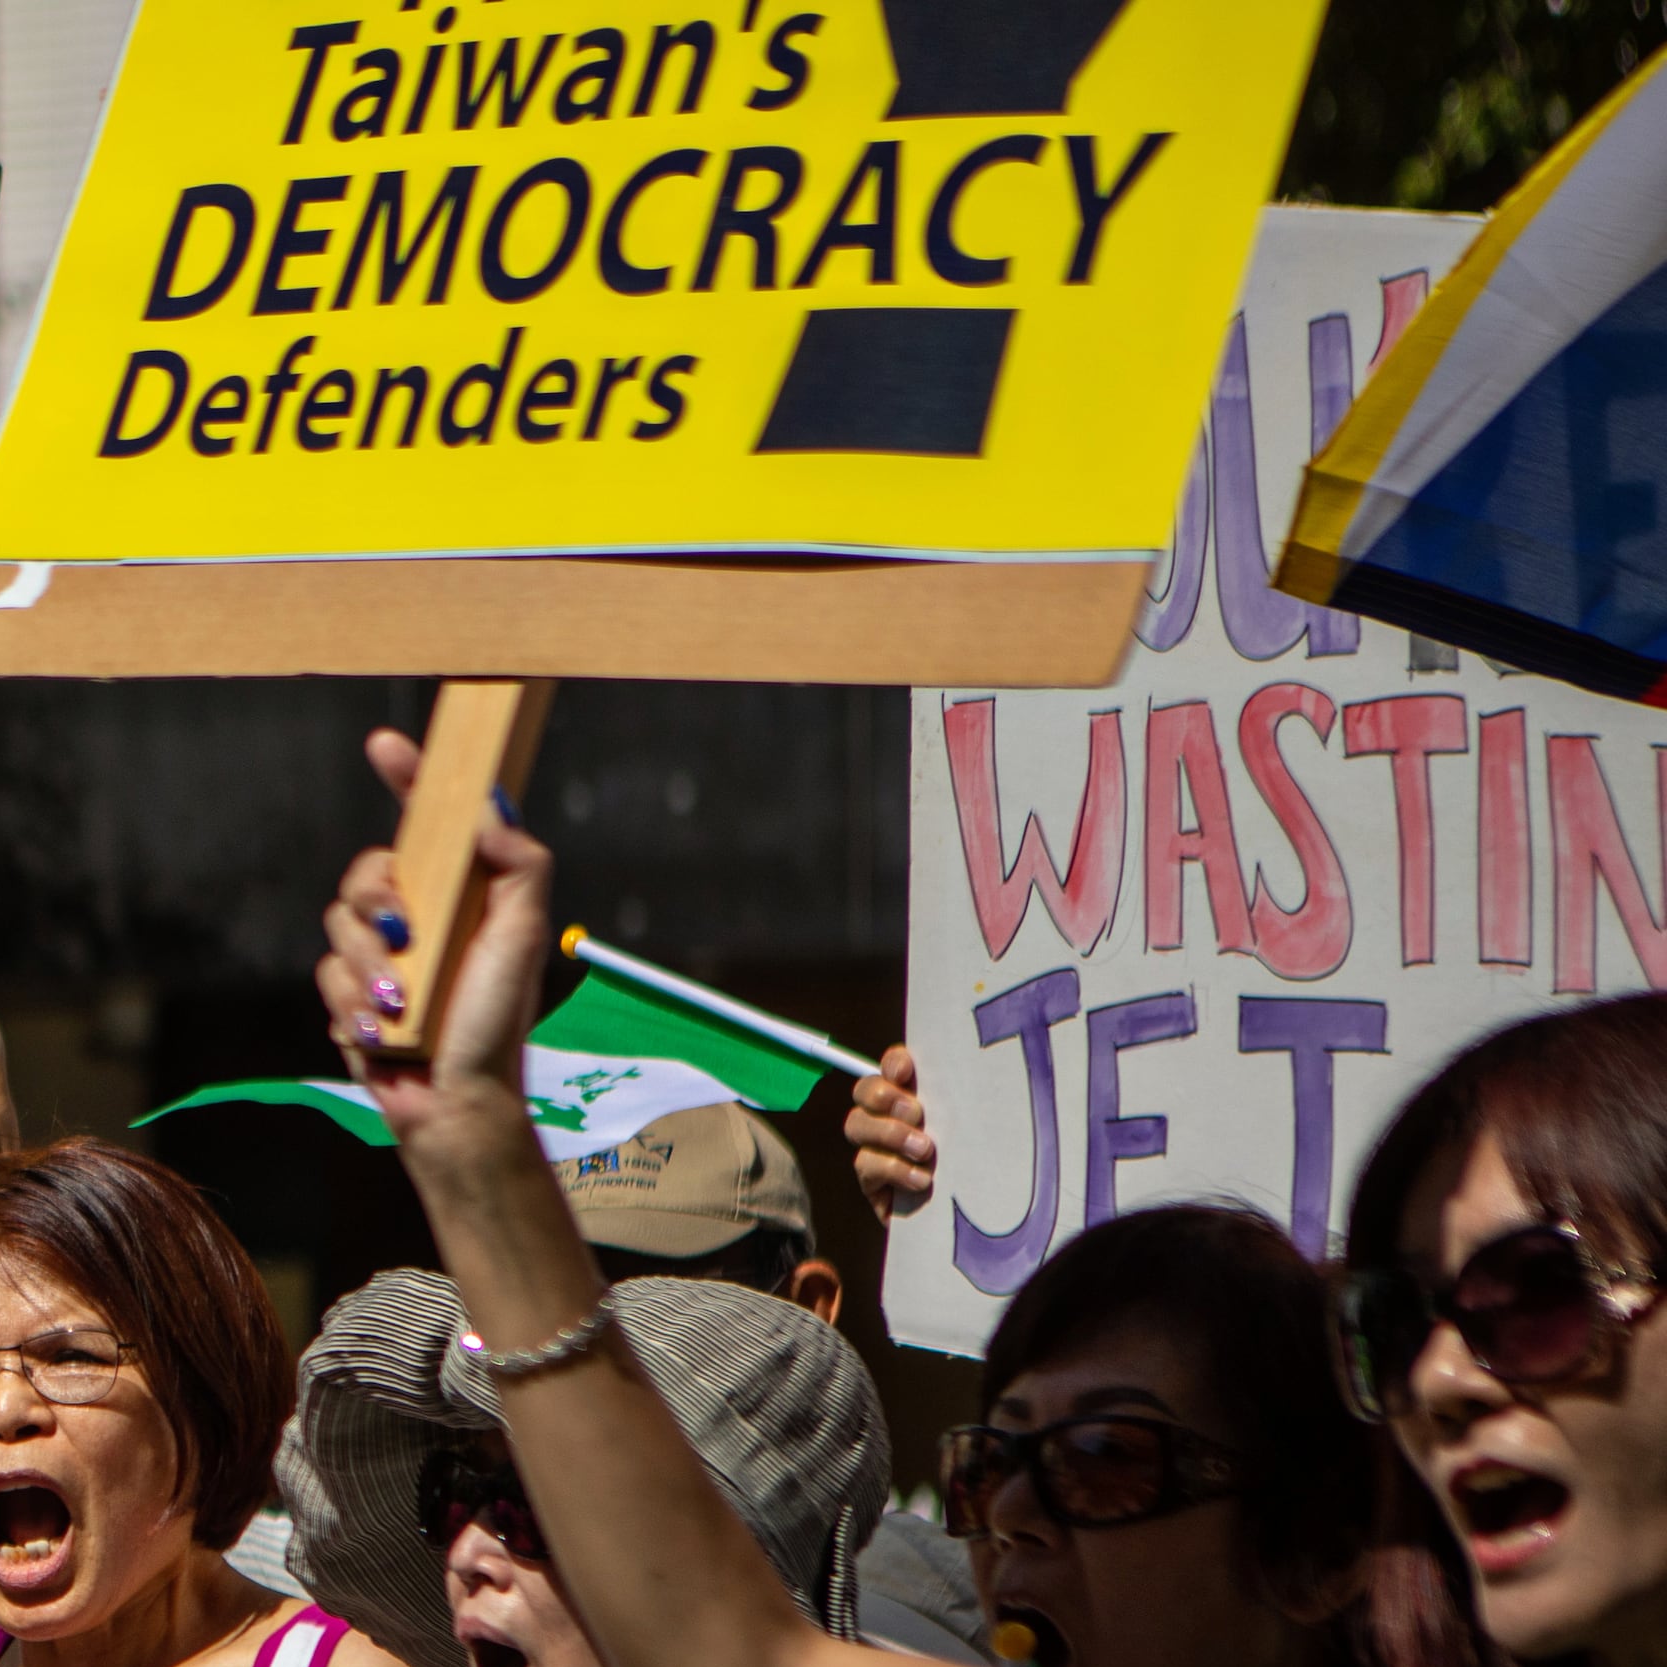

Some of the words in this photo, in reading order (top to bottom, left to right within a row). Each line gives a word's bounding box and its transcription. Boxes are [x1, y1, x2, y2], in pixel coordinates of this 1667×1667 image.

[280, 2, 819, 147] Taiwan's
[142, 131, 1174, 321] DEMOCRACY
[97, 327, 698, 460] Defenders
